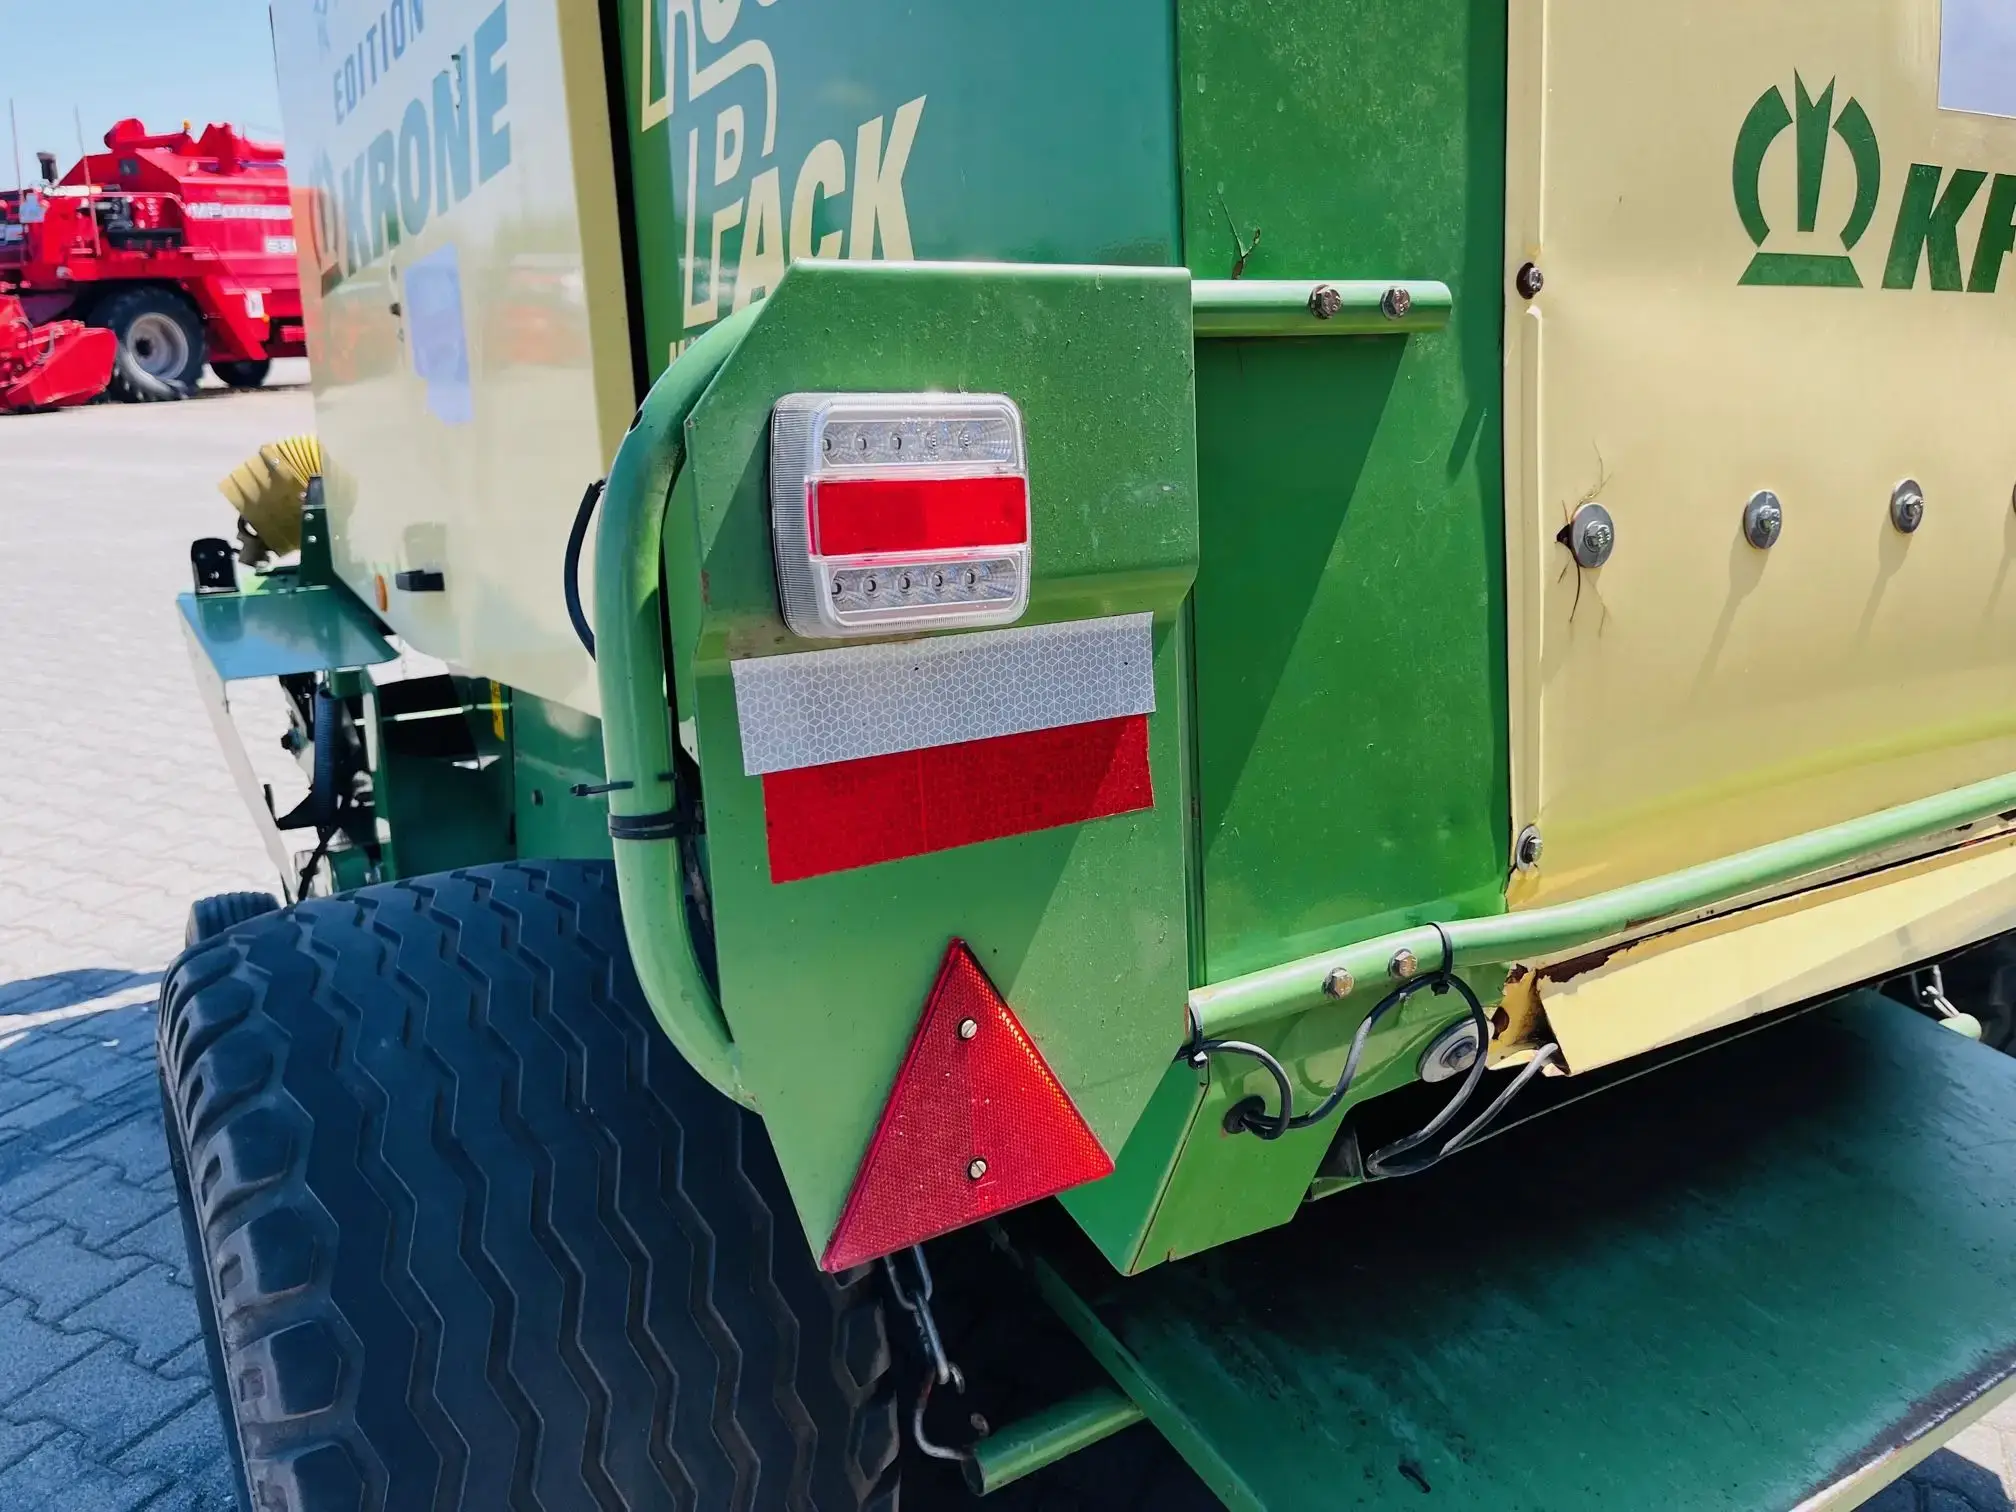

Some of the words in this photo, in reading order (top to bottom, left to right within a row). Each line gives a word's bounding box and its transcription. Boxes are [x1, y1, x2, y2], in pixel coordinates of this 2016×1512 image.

[333, 0, 424, 126] EDITION
[341, 0, 512, 278] KRONE
[683, 94, 927, 329] PACK
